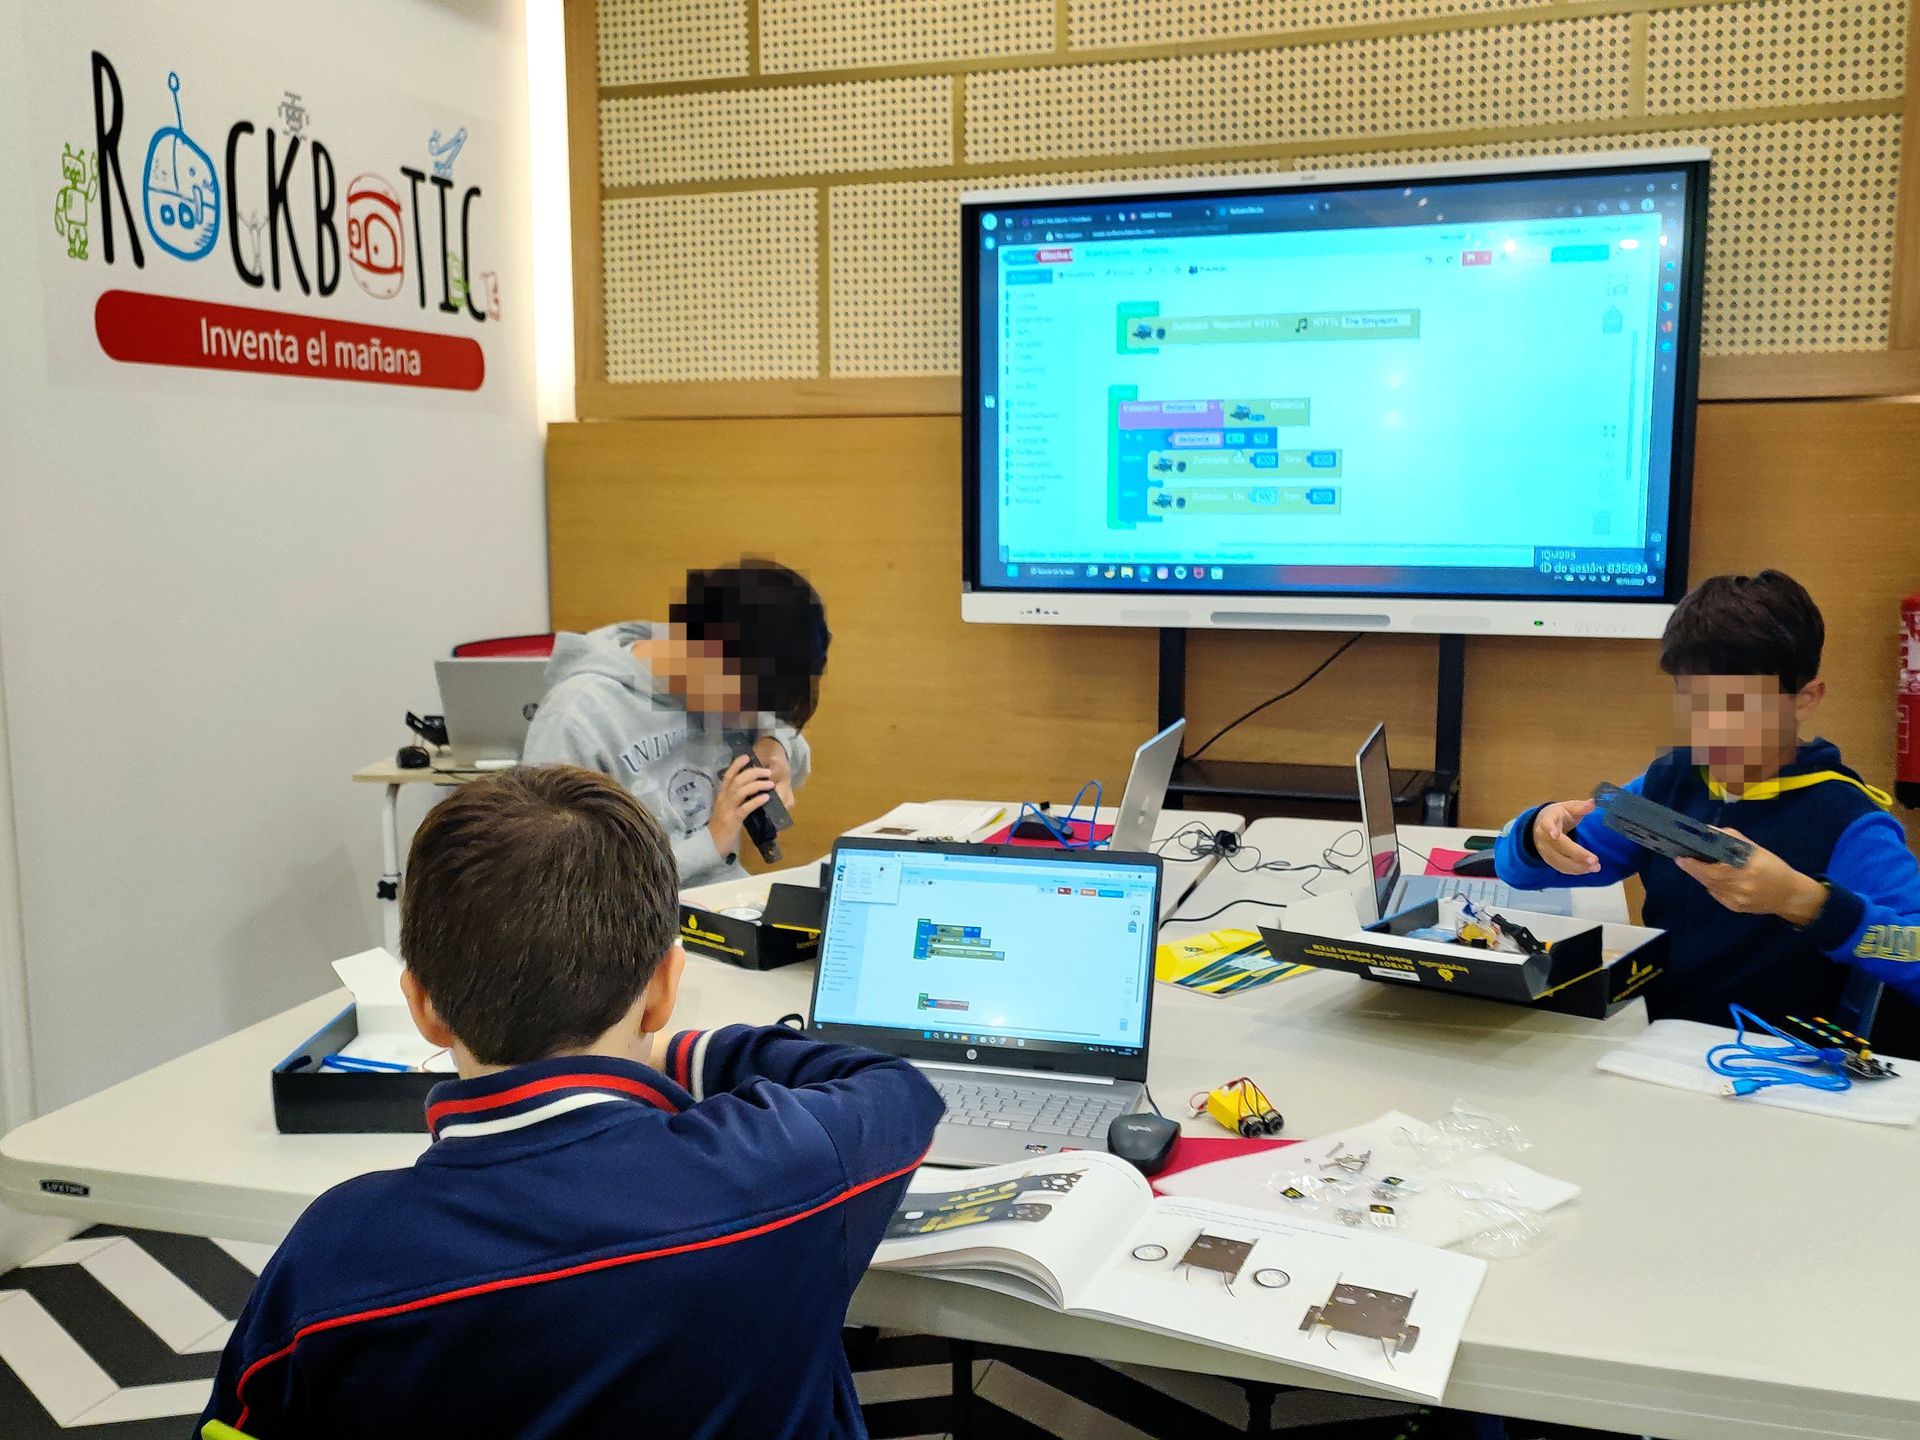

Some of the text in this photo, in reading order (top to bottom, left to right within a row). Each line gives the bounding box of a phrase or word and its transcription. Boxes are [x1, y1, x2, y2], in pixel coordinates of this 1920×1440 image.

[201, 317, 421, 376] Inventa el mañana
